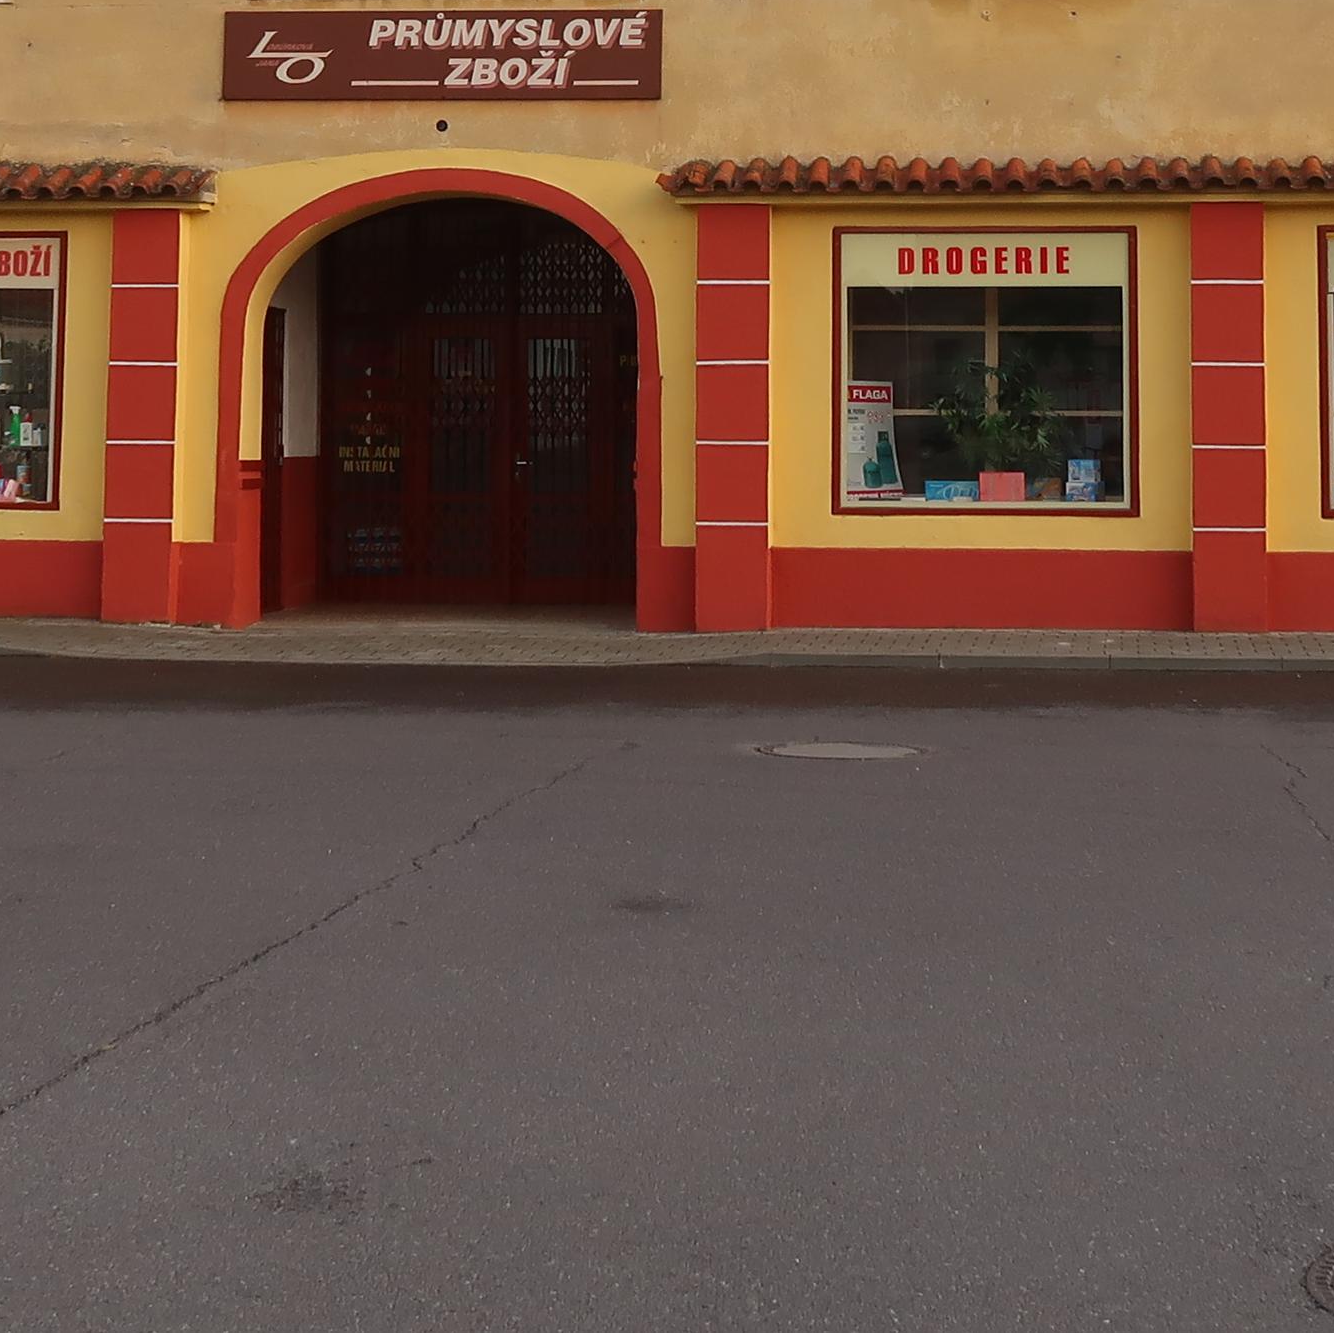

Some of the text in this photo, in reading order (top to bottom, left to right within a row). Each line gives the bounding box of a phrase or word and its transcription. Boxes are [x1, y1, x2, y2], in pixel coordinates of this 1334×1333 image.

[368, 11, 648, 49] PRŮMYSLOVÉ
[443, 51, 575, 88] ZBOŽÍ
[897, 247, 1070, 275] DROGERIE
[852, 389, 889, 400] FLAGA
